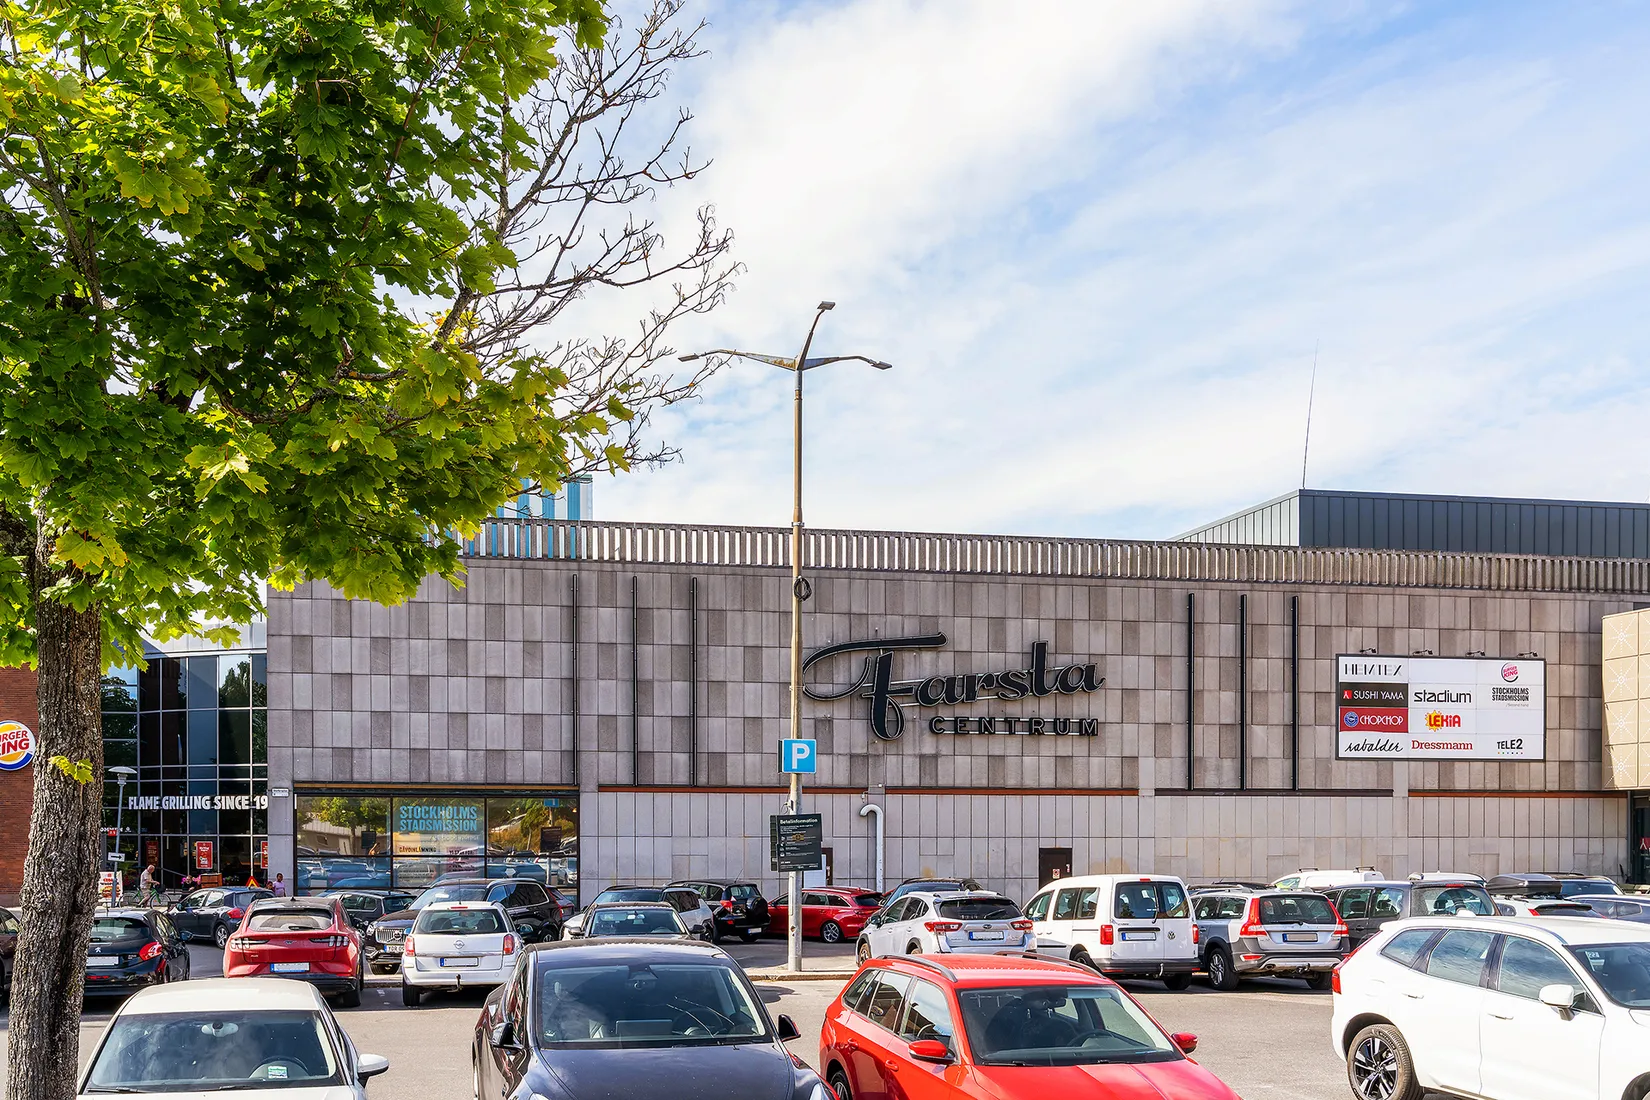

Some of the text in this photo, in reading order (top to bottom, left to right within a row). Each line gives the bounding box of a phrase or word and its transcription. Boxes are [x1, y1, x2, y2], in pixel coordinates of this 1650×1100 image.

[1503, 669, 1519, 679] KING
[803, 632, 1106, 741] Farsta
[1491, 687, 1530, 695] STOCKHOLMS
[1353, 690, 1404, 700] SUSHI YAMA
[1413, 689, 1472, 703] stadium
[929, 715, 1099, 736] CENTRUM
[1359, 714, 1404, 726] CHOPCHOP
[0, 730, 28, 743] RGER
[0, 738, 30, 756] ING
[1411, 740, 1473, 750] Dressmann
[1496, 738, 1523, 750] TELE2
[791, 743, 811, 769] P
[128, 796, 159, 810] FLAME
[161, 795, 211, 810] GRILLING
[214, 795, 249, 810] SINCE
[400, 805, 477, 819] STOCKHOLMS
[400, 820, 477, 832] STADSMISSION
